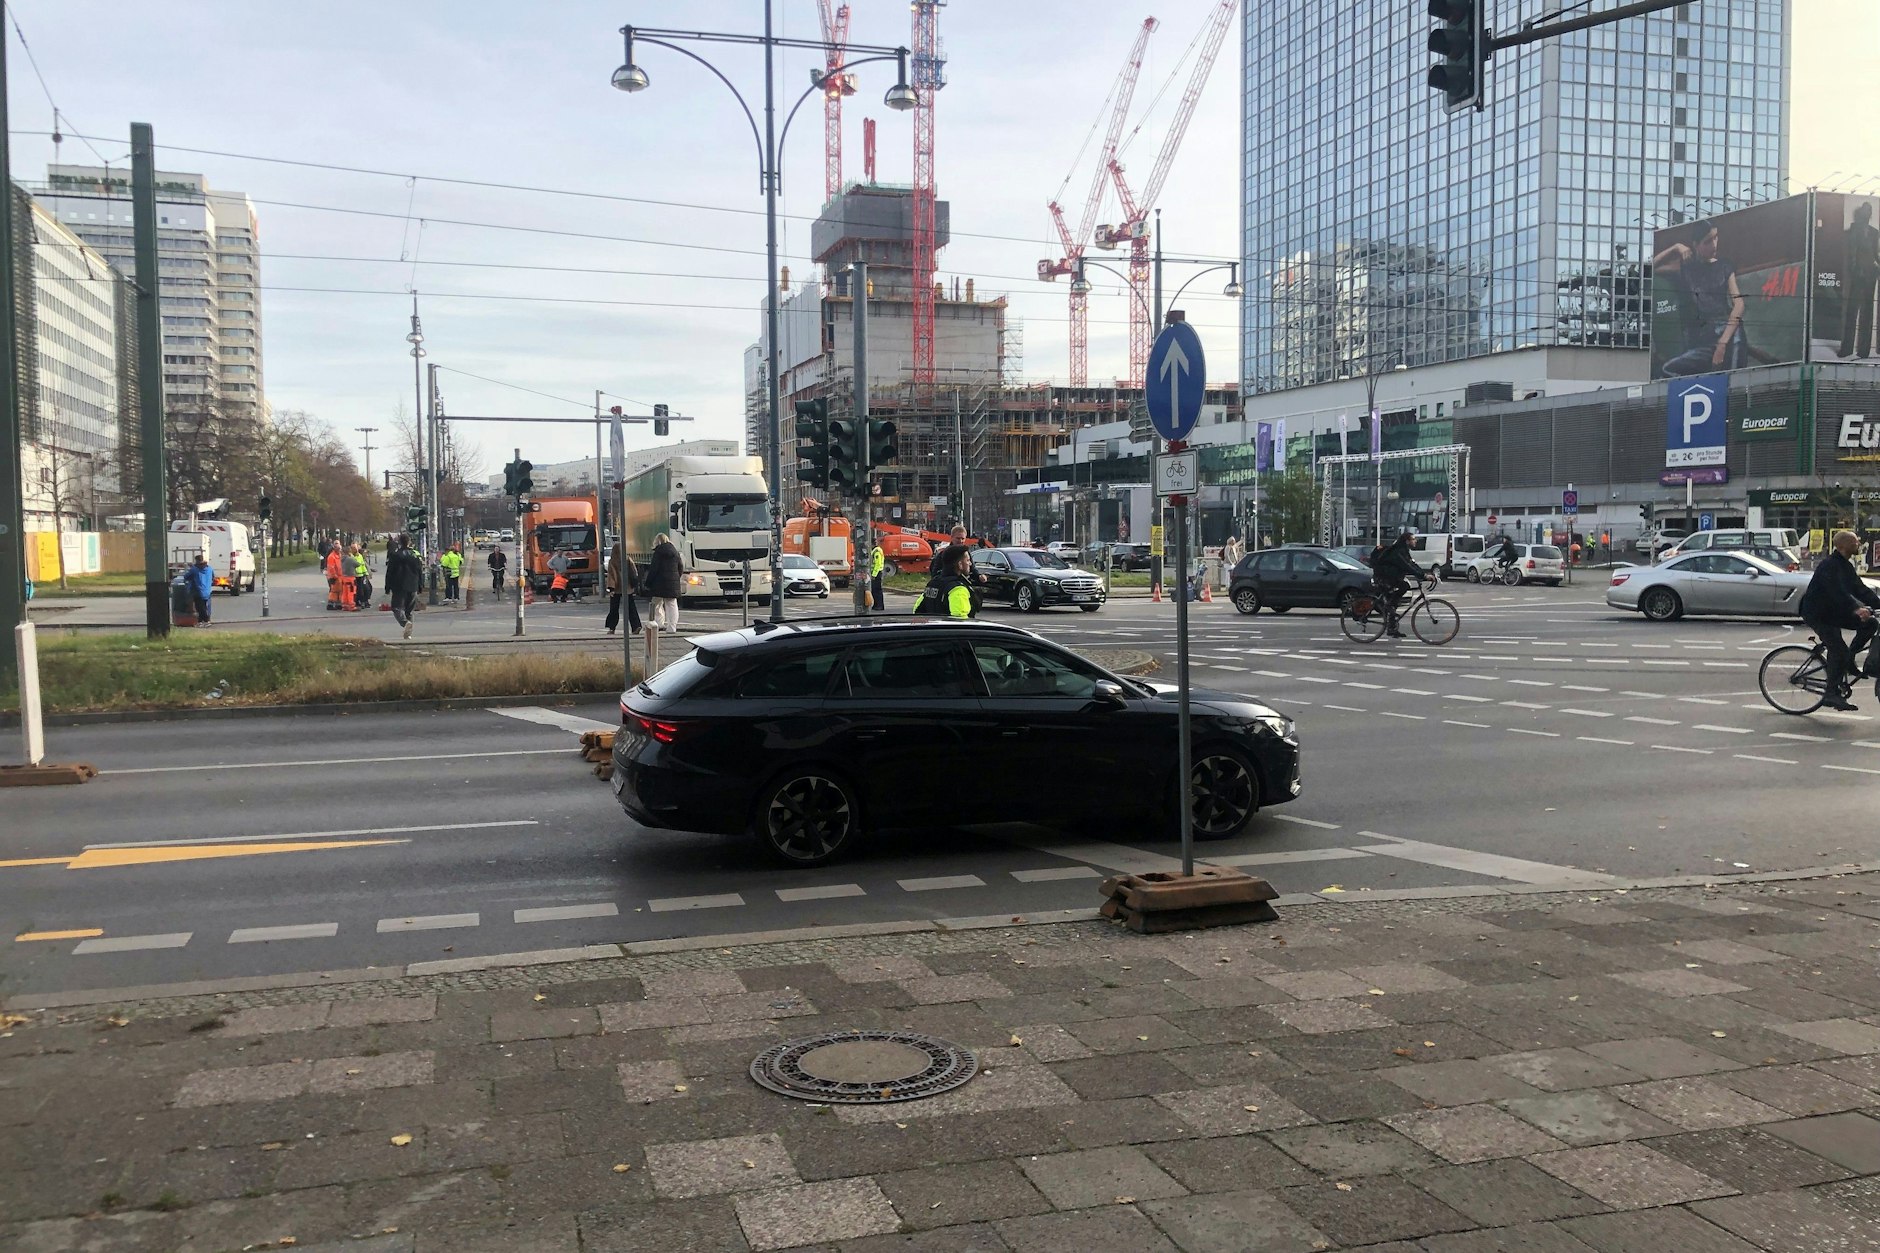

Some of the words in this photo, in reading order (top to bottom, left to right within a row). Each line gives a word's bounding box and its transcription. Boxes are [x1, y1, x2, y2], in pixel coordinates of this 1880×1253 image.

[1818, 272, 1836, 280] HOSE
[1683, 393, 1712, 443] P
[1742, 417, 1788, 431] Europcar
[1682, 452, 1693, 461] 2€
[1770, 491, 1808, 502] Europcar
[1703, 518, 1709, 528] P
